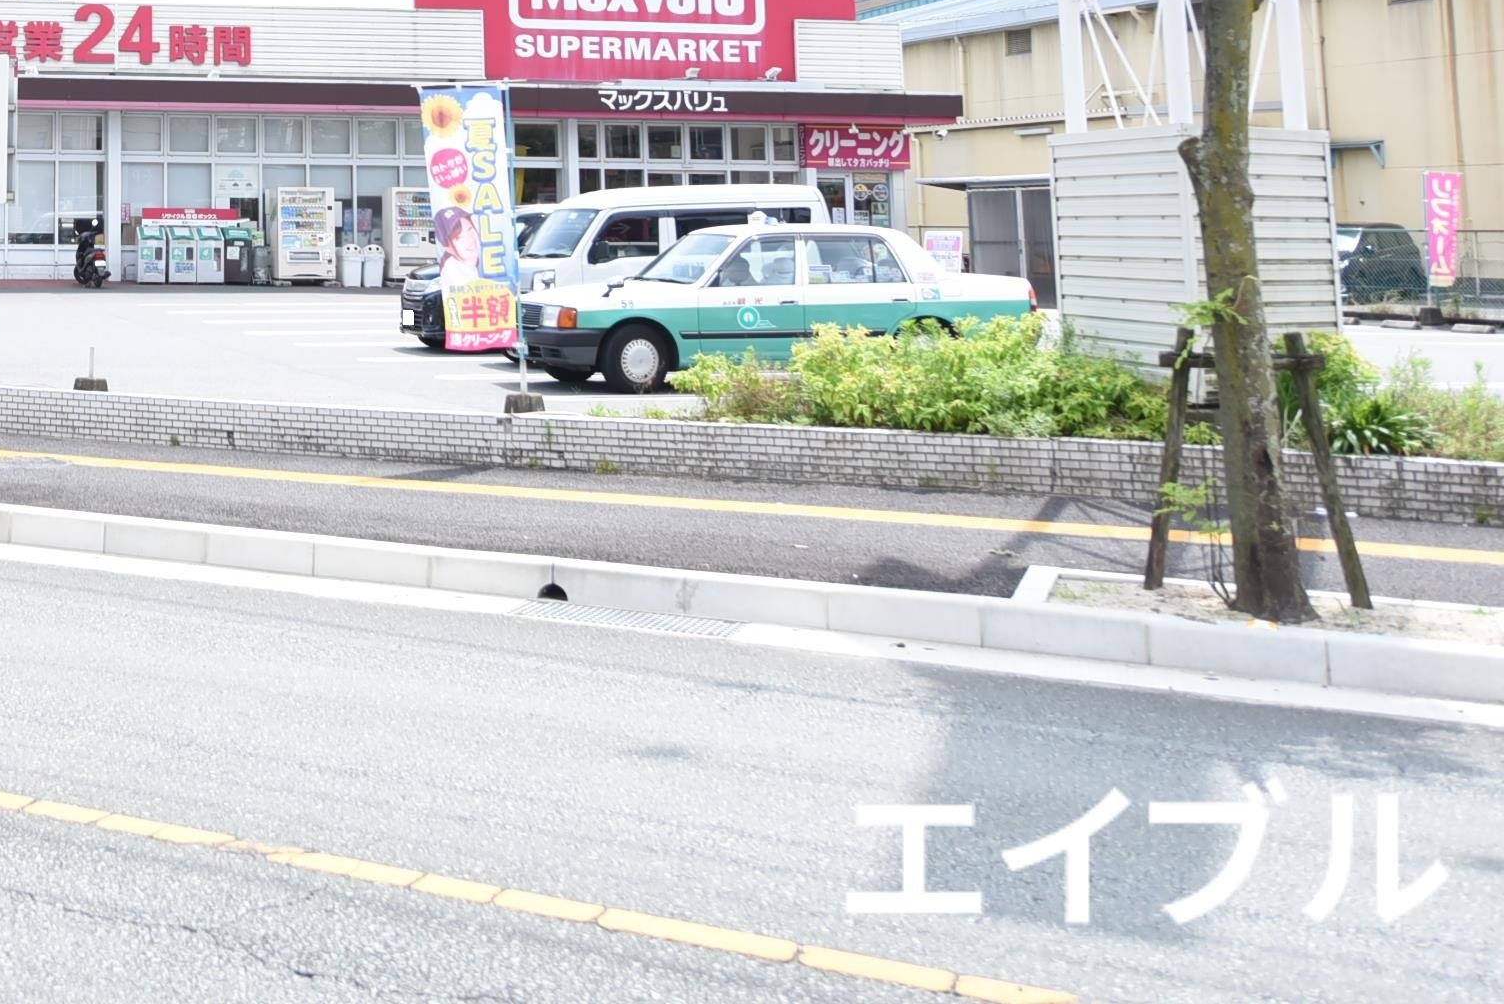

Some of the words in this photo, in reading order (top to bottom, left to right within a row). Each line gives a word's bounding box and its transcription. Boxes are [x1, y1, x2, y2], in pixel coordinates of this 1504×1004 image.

[514, 33, 763, 63] SUPERMARKET
[598, 89, 728, 112] マックスバリュ
[809, 129, 905, 158] クリーニング
[463, 118, 507, 279] 夏SALE
[461, 293, 511, 328] 半額
